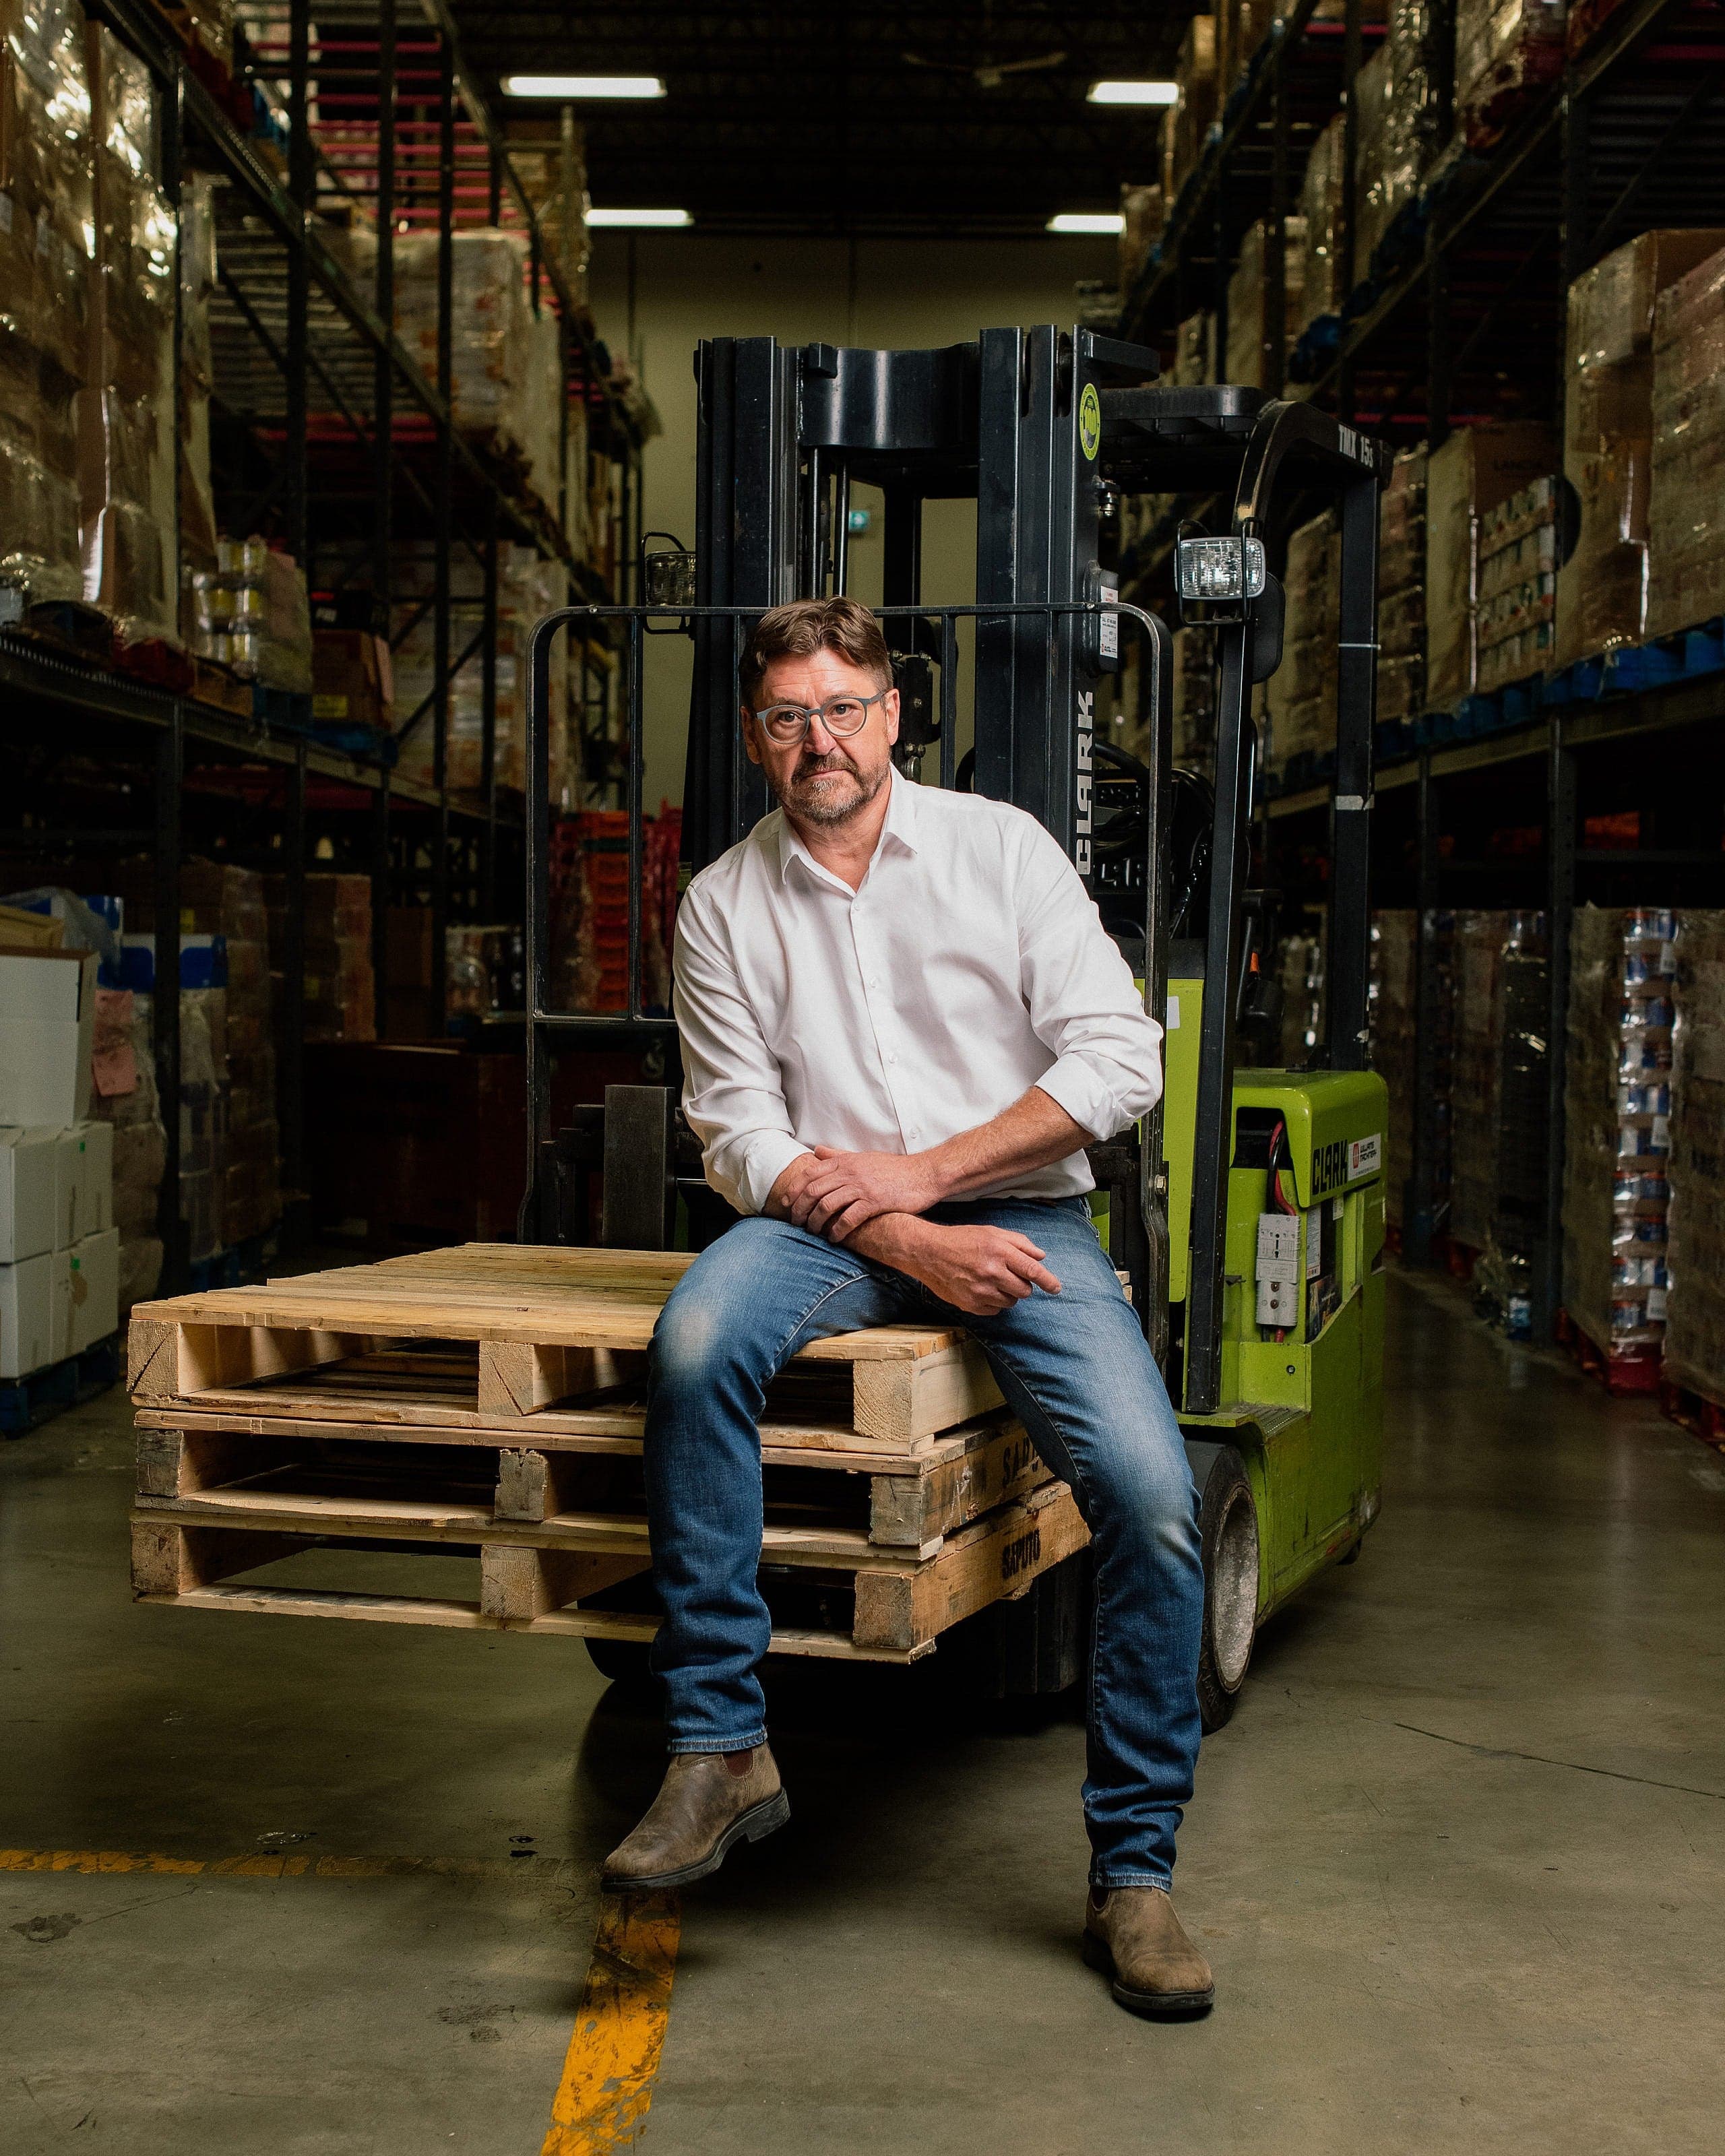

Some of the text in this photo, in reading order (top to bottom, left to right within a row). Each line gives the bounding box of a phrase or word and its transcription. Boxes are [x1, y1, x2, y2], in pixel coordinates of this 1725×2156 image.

[1338, 424, 1356, 459] TMX
[1076, 690, 1093, 875] CLARK
[1312, 1139, 1348, 1195] CLARK
[1002, 1528, 1040, 1579] SAPUTO
